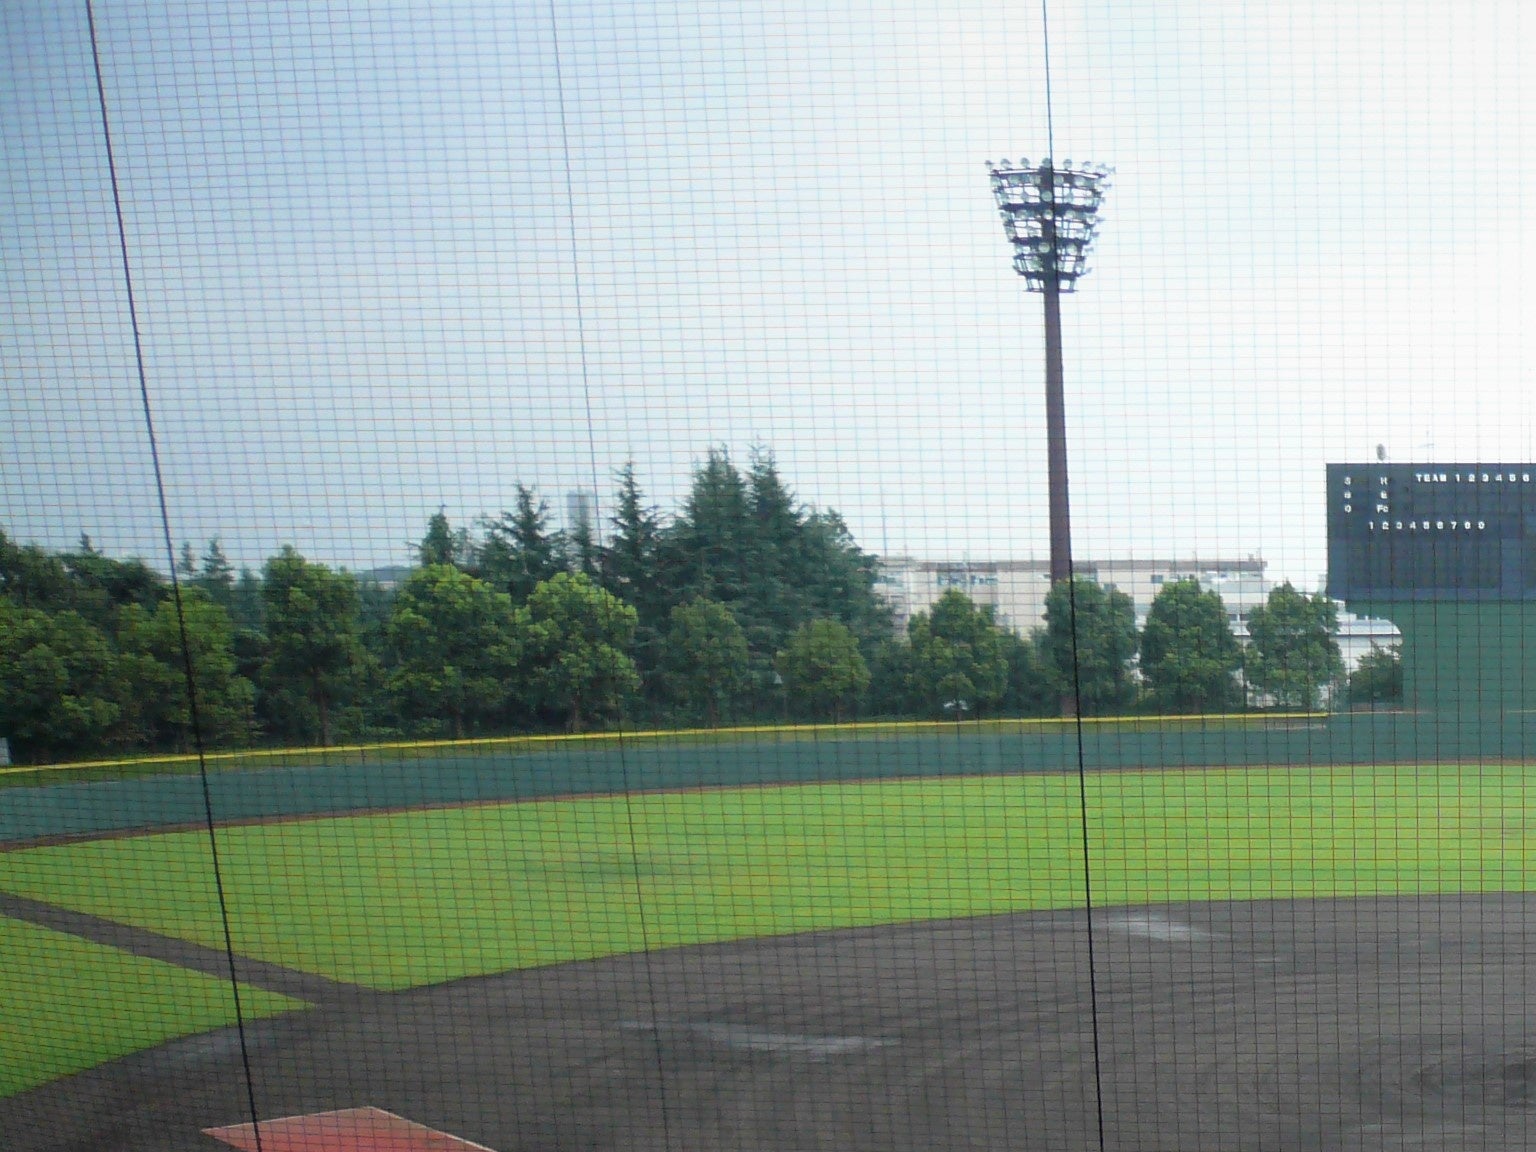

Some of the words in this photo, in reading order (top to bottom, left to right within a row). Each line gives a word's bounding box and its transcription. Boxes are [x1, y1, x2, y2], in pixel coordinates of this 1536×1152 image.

[1415, 472, 1448, 483] TEAM
[1454, 472, 1461, 483] 1
[1468, 472, 1476, 483] 2
[1481, 472, 1490, 483] 3
[1494, 472, 1503, 483] 4
[1508, 472, 1517, 483] 5
[1521, 472, 1530, 483] 6
[1368, 520, 1374, 531] 1
[1381, 520, 1390, 531] 2
[1395, 520, 1403, 531] 3
[1409, 520, 1417, 531] 4
[1422, 520, 1430, 531] 5
[1436, 520, 1444, 531] 6
[1450, 520, 1458, 531] 7
